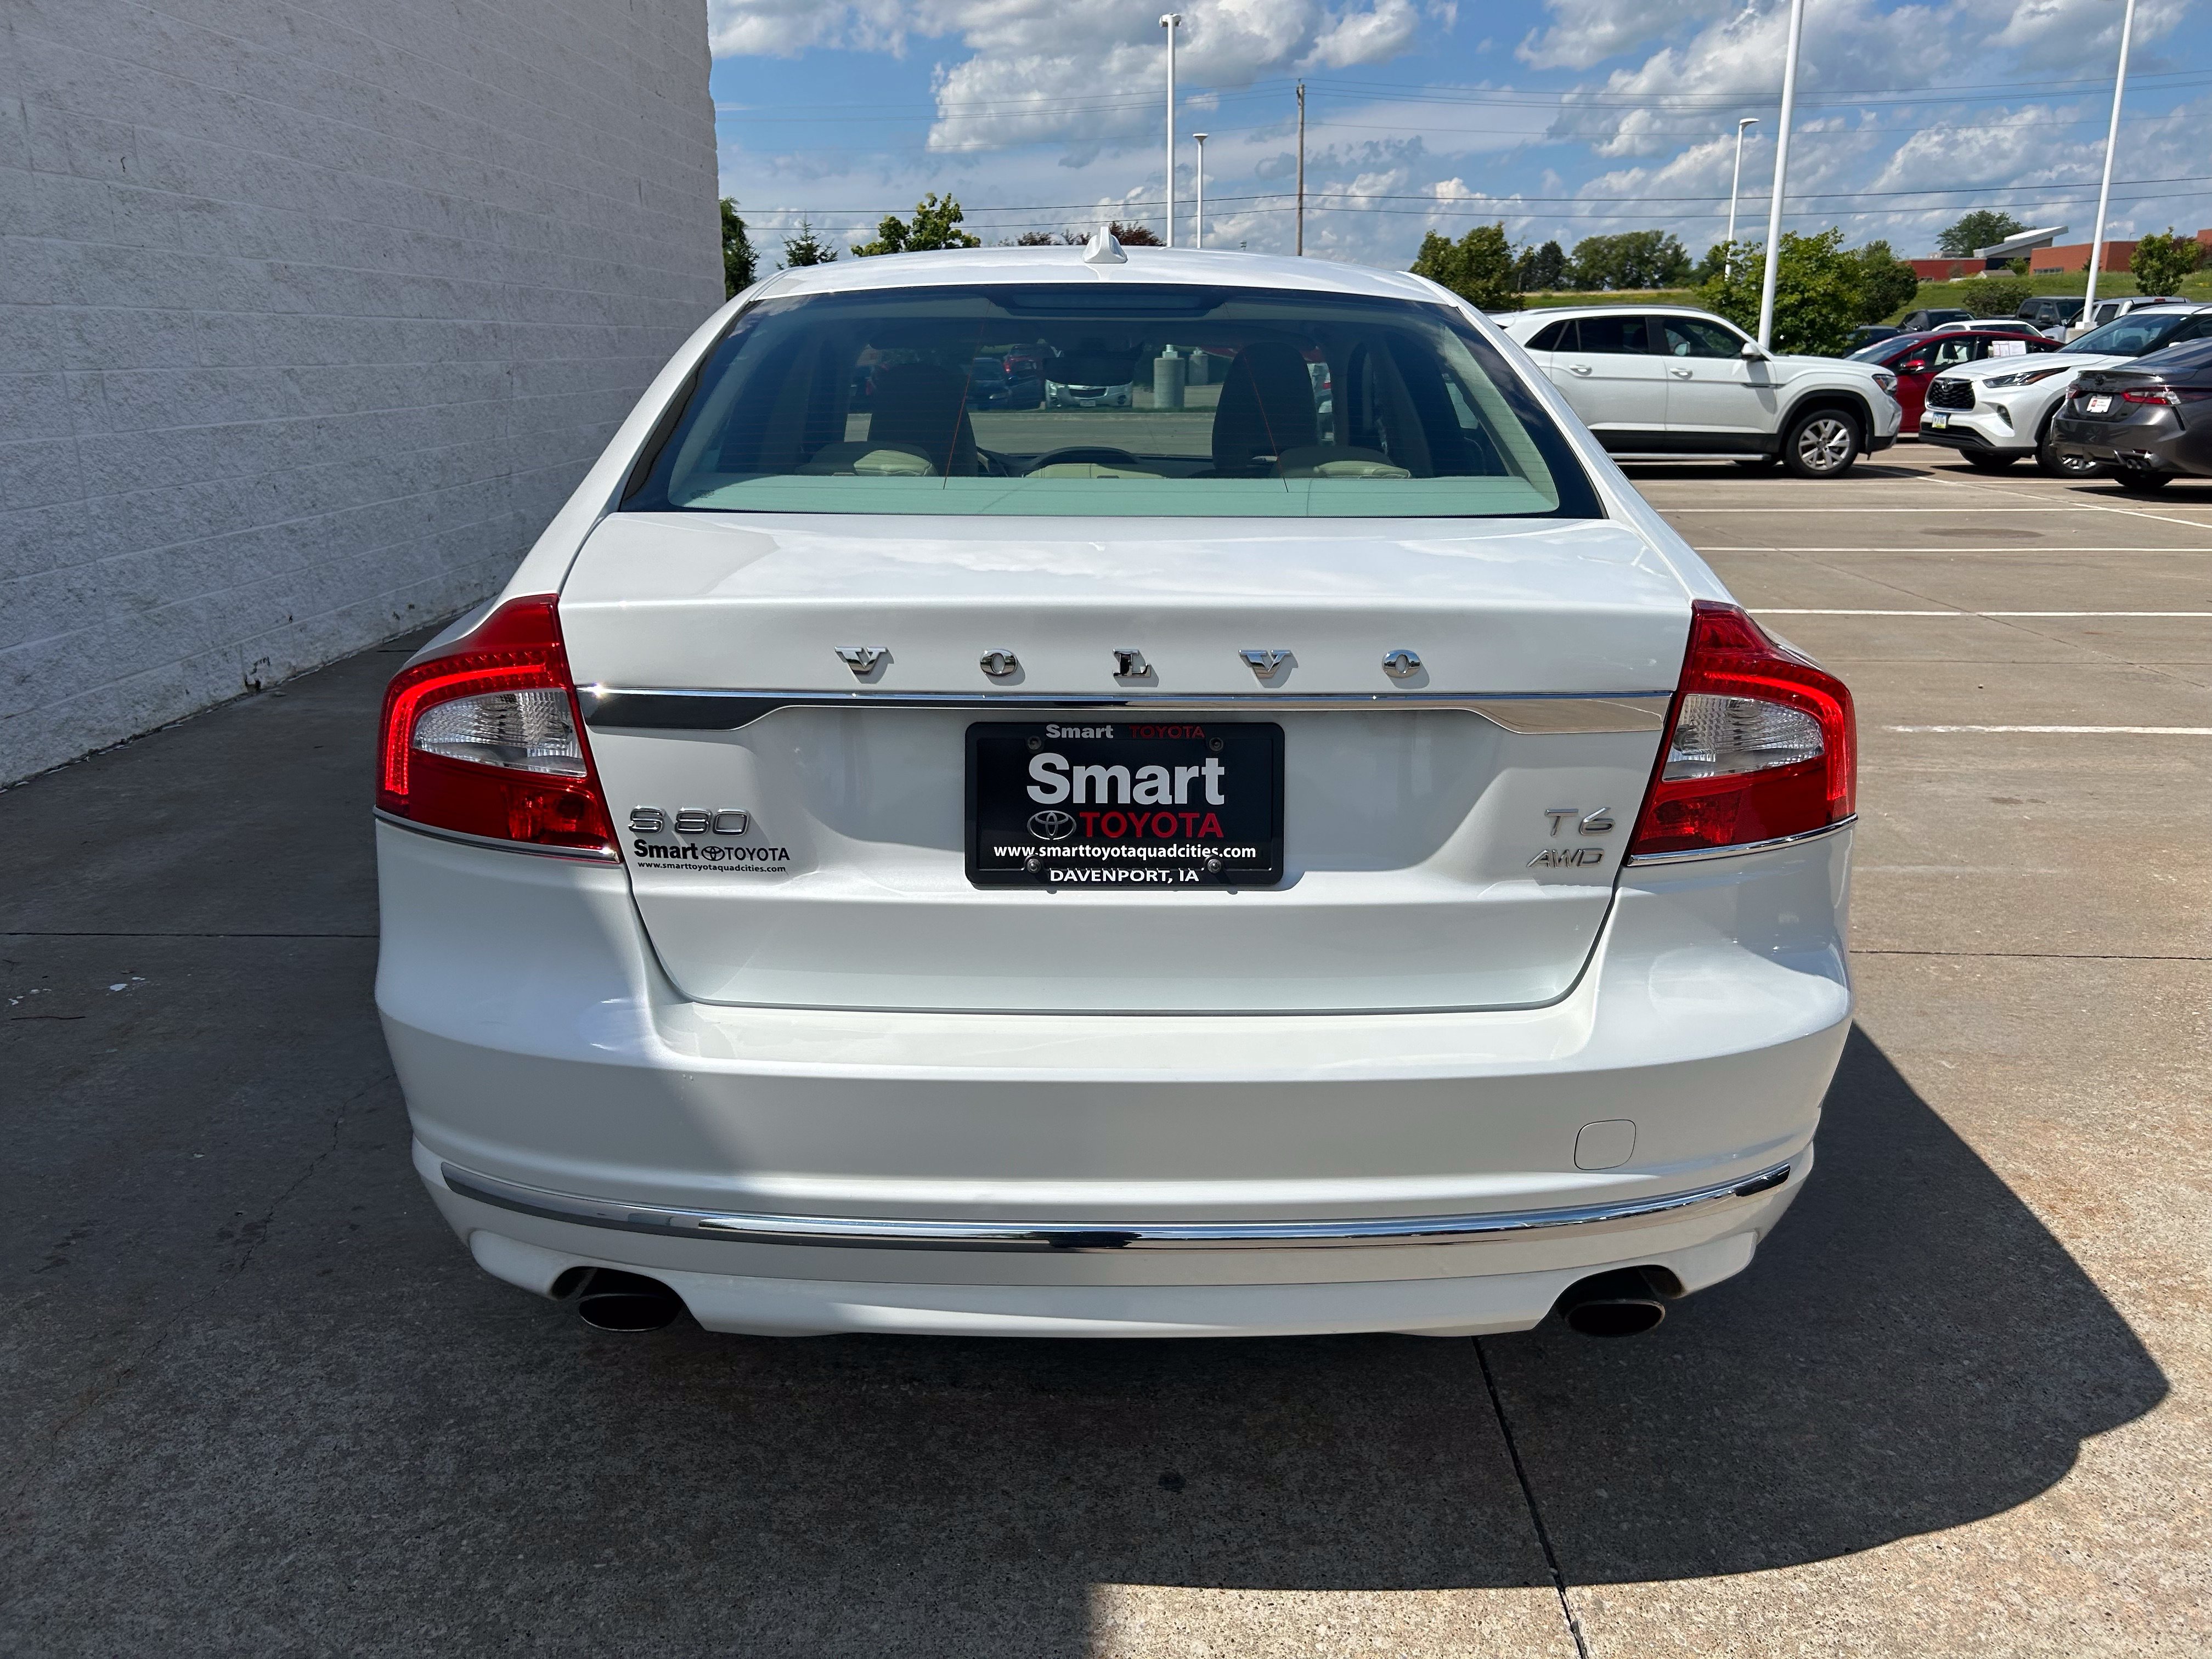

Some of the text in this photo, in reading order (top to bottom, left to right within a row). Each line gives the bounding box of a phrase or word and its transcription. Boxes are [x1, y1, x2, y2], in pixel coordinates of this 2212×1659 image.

[834, 646, 1421, 679] VOLVO
[1046, 724, 1205, 739] Smart TOYOTA
[1026, 752, 1225, 805] Smart
[1079, 812, 1224, 838] TOYOTA
[1545, 807, 1616, 838] T6
[634, 839, 790, 861] Smart TOYOTA
[994, 843, 1256, 861] www.smarttoyotaquadcities.com
[1527, 848, 1605, 868] AWD
[637, 861, 786, 872] www.smarttoyotaquadcities.com
[1049, 868, 1200, 884] DAVENPORT, IA
